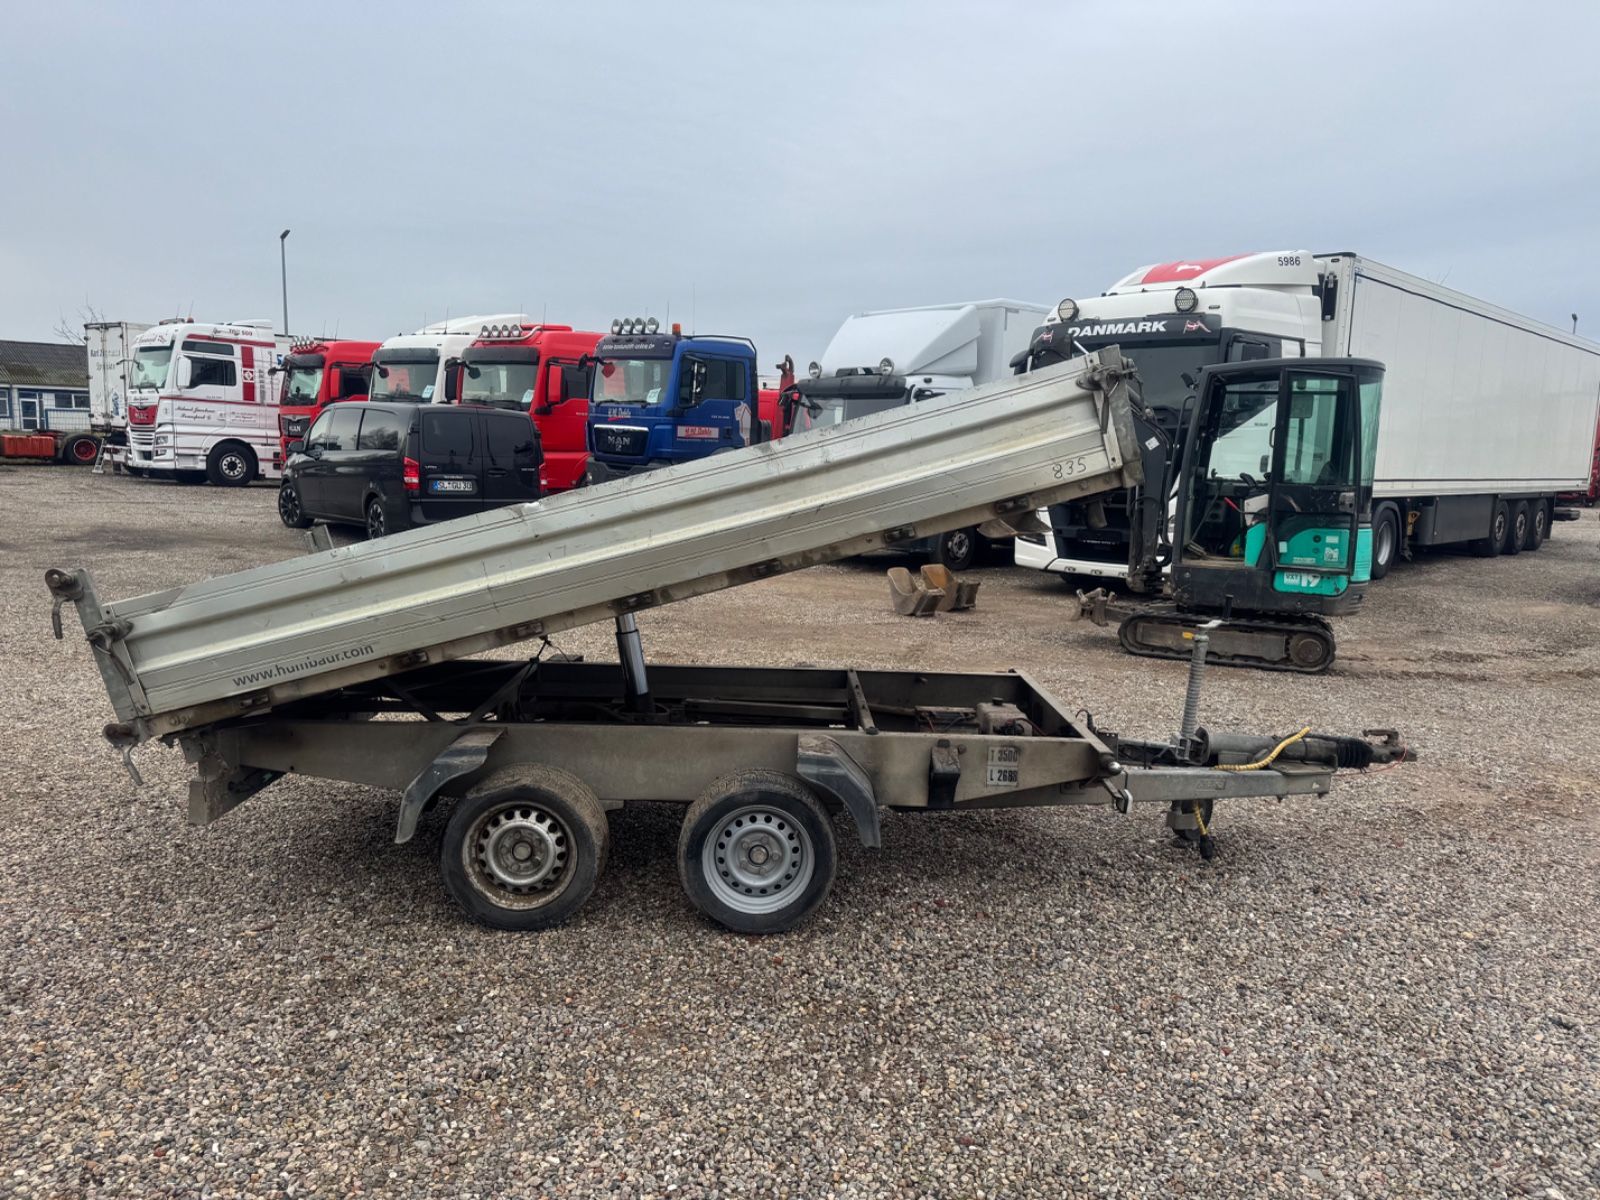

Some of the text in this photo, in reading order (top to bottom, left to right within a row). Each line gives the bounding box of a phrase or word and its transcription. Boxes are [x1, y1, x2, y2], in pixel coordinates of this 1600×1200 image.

[1277, 256, 1301, 267] 5986
[1067, 320, 1168, 338] DANMARK
[607, 435, 631, 446] MAN
[1052, 456, 1087, 480] 835
[232, 644, 375, 687] www.humbaur.com
[997, 750, 1018, 762] 3500
[989, 769, 995, 781] L
